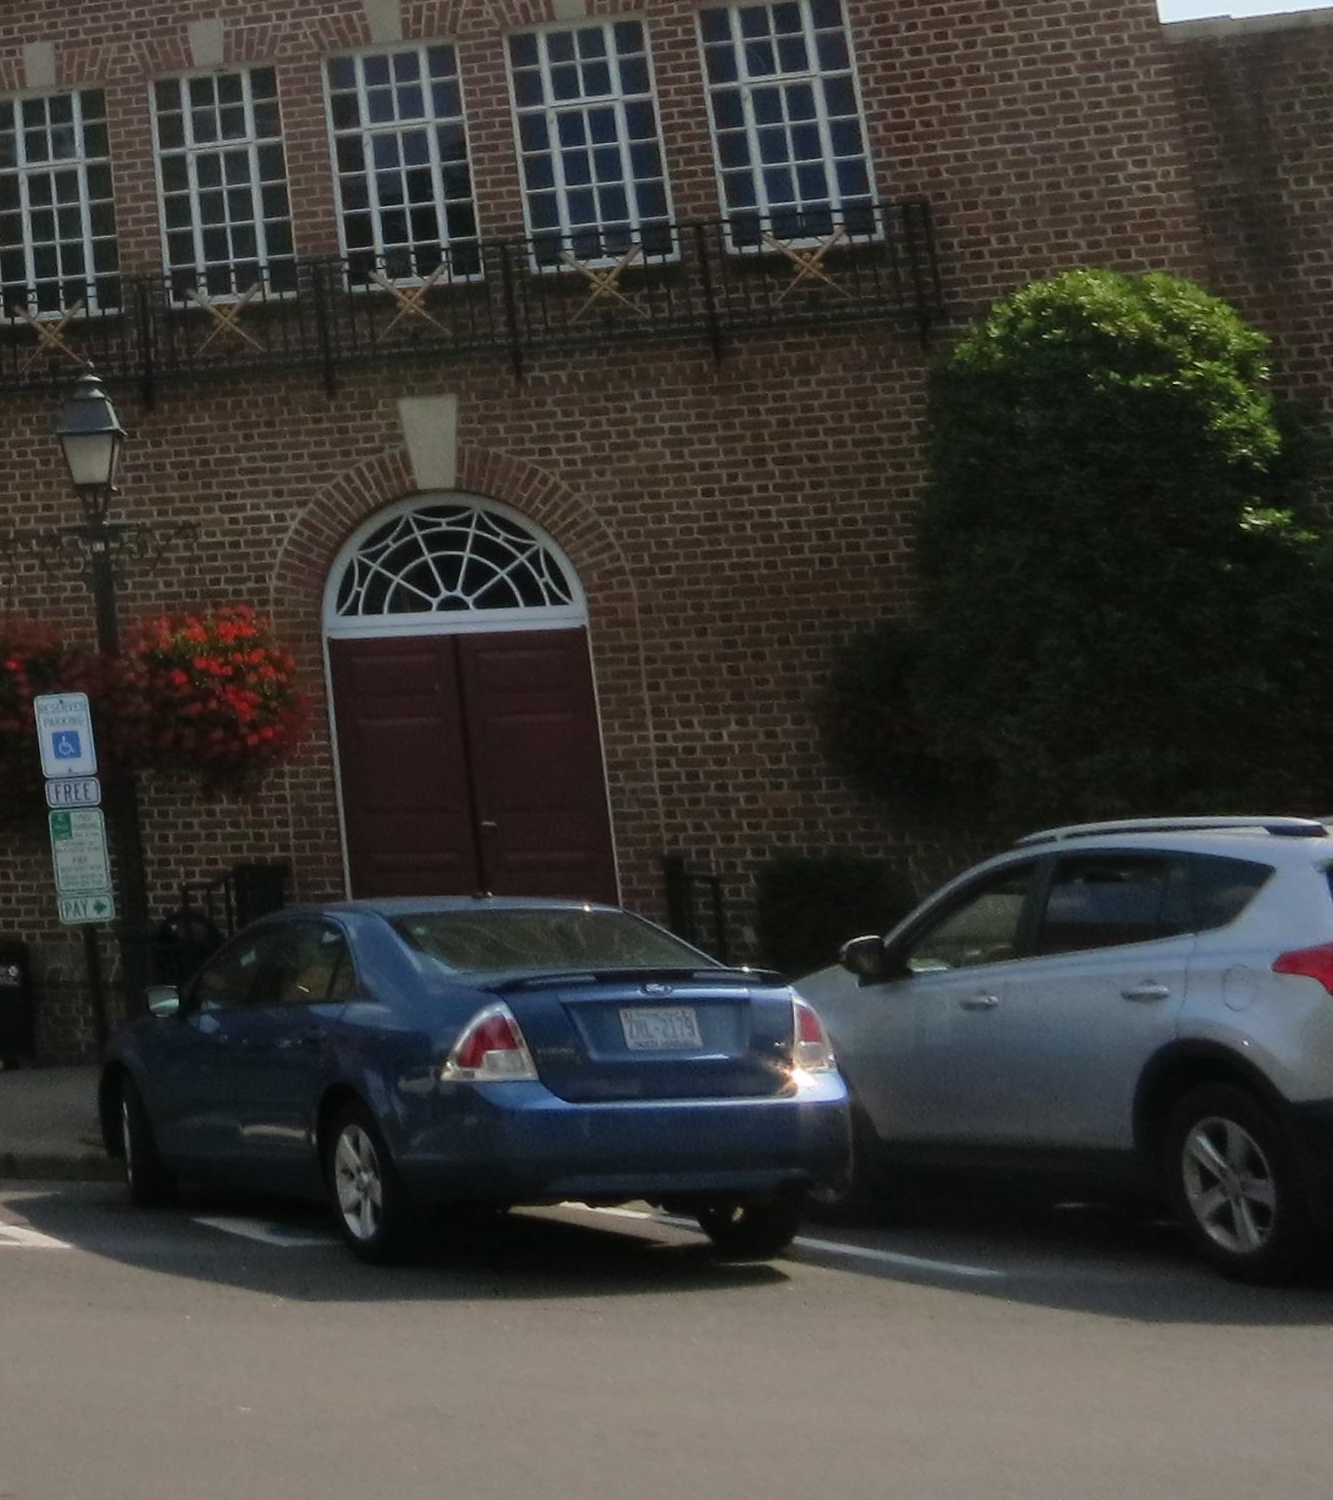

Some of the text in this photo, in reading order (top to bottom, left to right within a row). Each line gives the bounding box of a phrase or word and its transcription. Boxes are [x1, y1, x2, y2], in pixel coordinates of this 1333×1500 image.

[43, 716, 85, 728] PARKING
[54, 782, 92, 803] FREE
[63, 899, 89, 918] PAY
